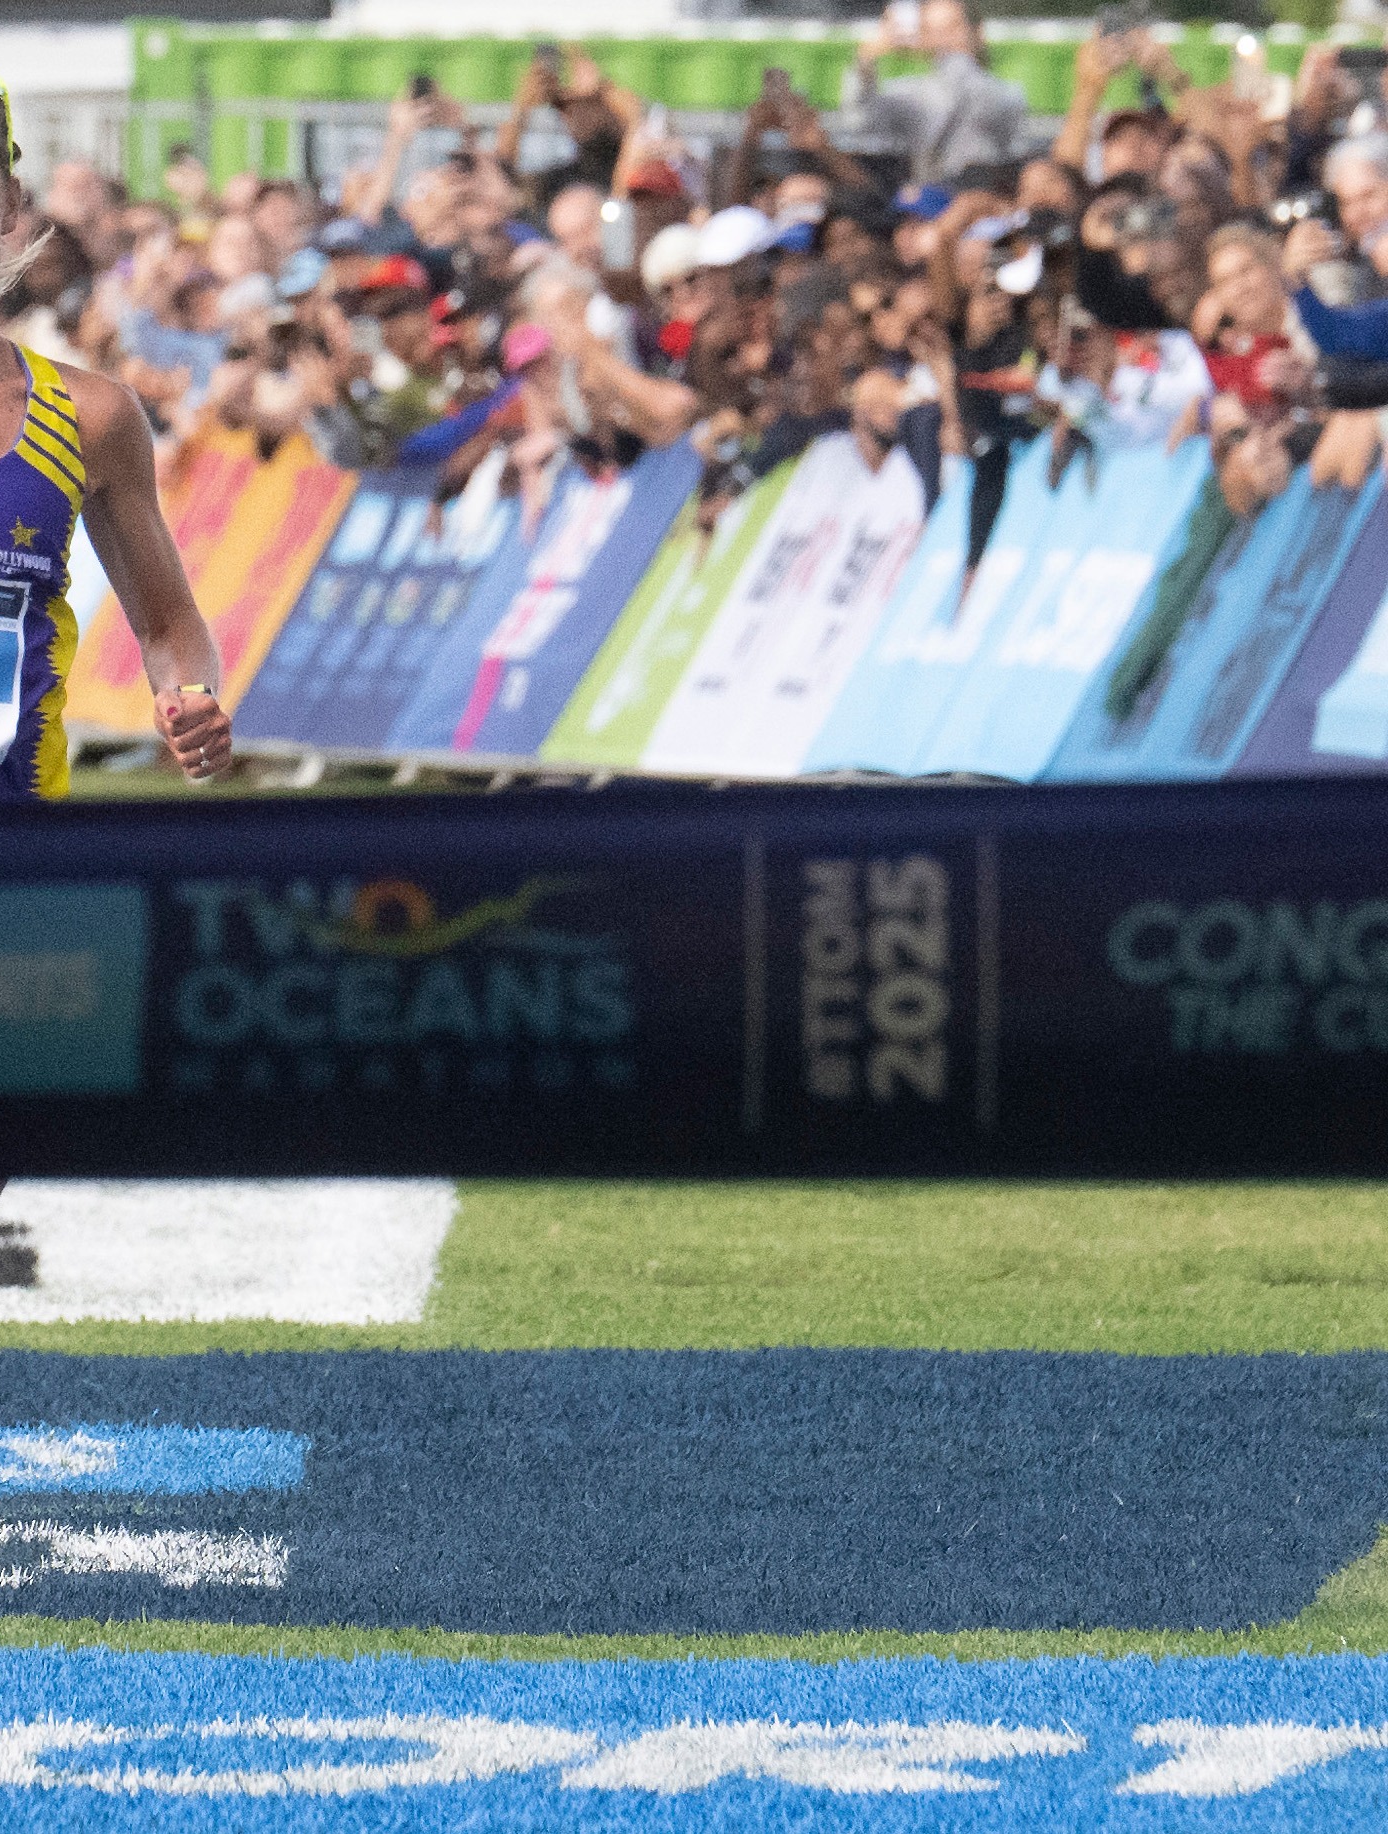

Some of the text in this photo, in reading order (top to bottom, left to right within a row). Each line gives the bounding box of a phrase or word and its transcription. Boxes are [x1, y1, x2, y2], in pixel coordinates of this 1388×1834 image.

[174, 960, 636, 1044] OCEANS
[865, 853, 950, 1100] 2025
[1167, 990, 1299, 1052] THE
